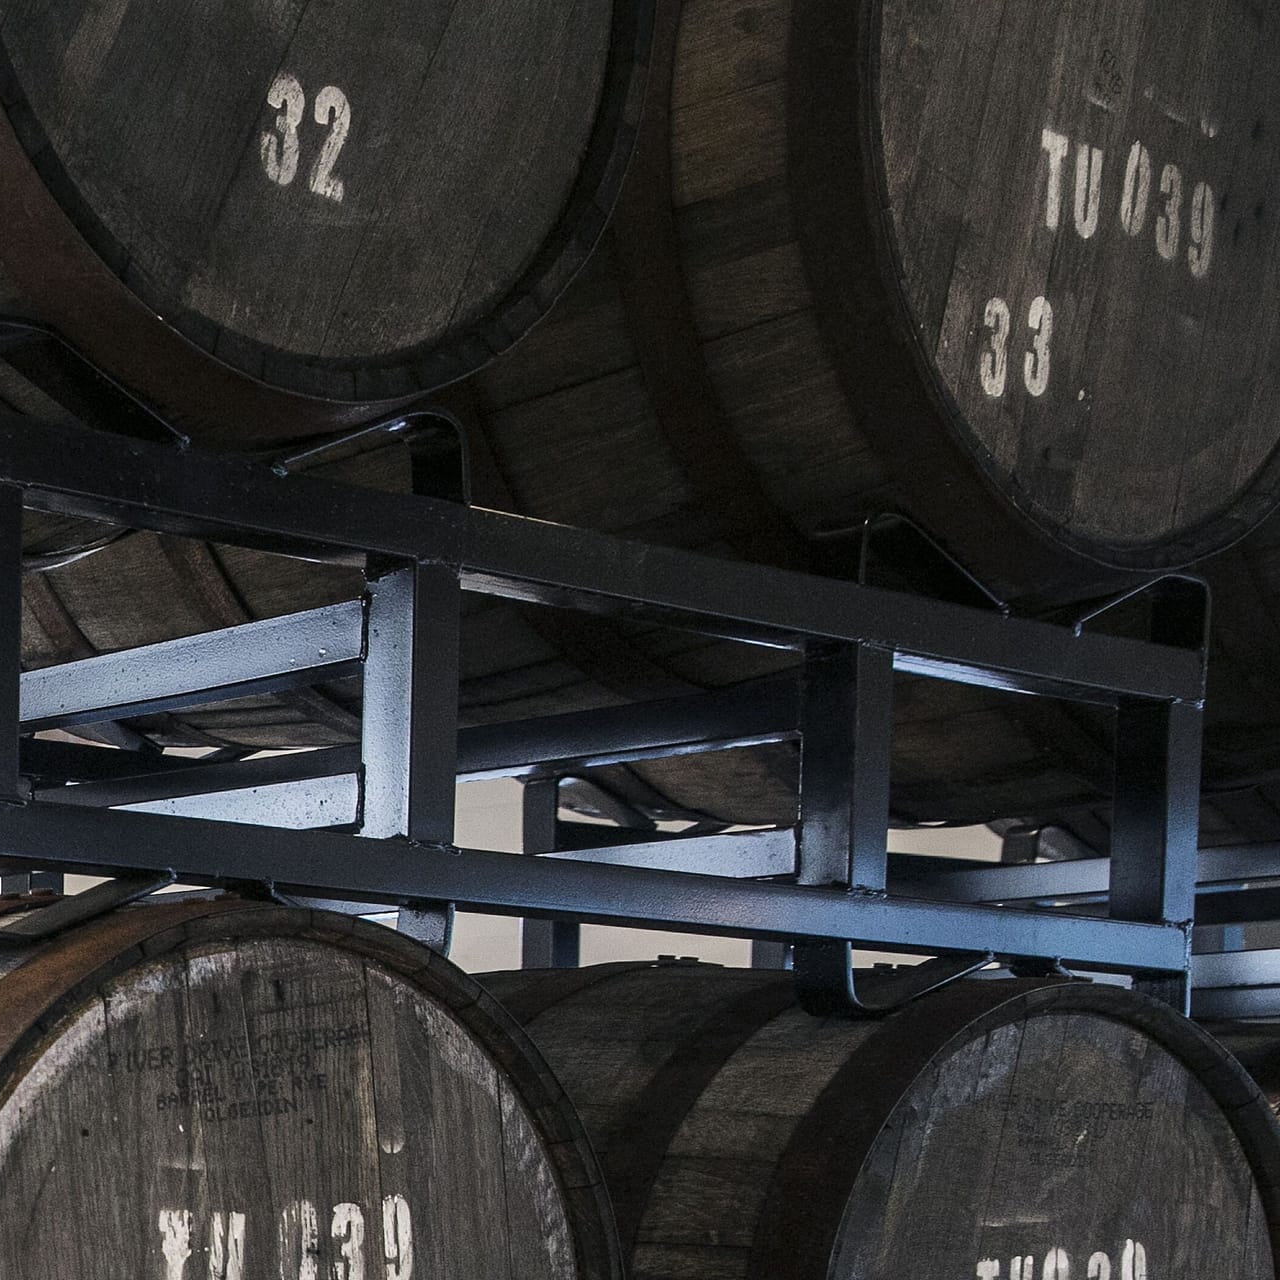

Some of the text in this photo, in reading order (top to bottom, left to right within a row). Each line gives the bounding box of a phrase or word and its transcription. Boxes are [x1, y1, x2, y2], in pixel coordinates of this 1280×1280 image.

[260, 73, 351, 202] 32
[1041, 128, 1104, 239] TU
[979, 296, 1054, 398] 33
